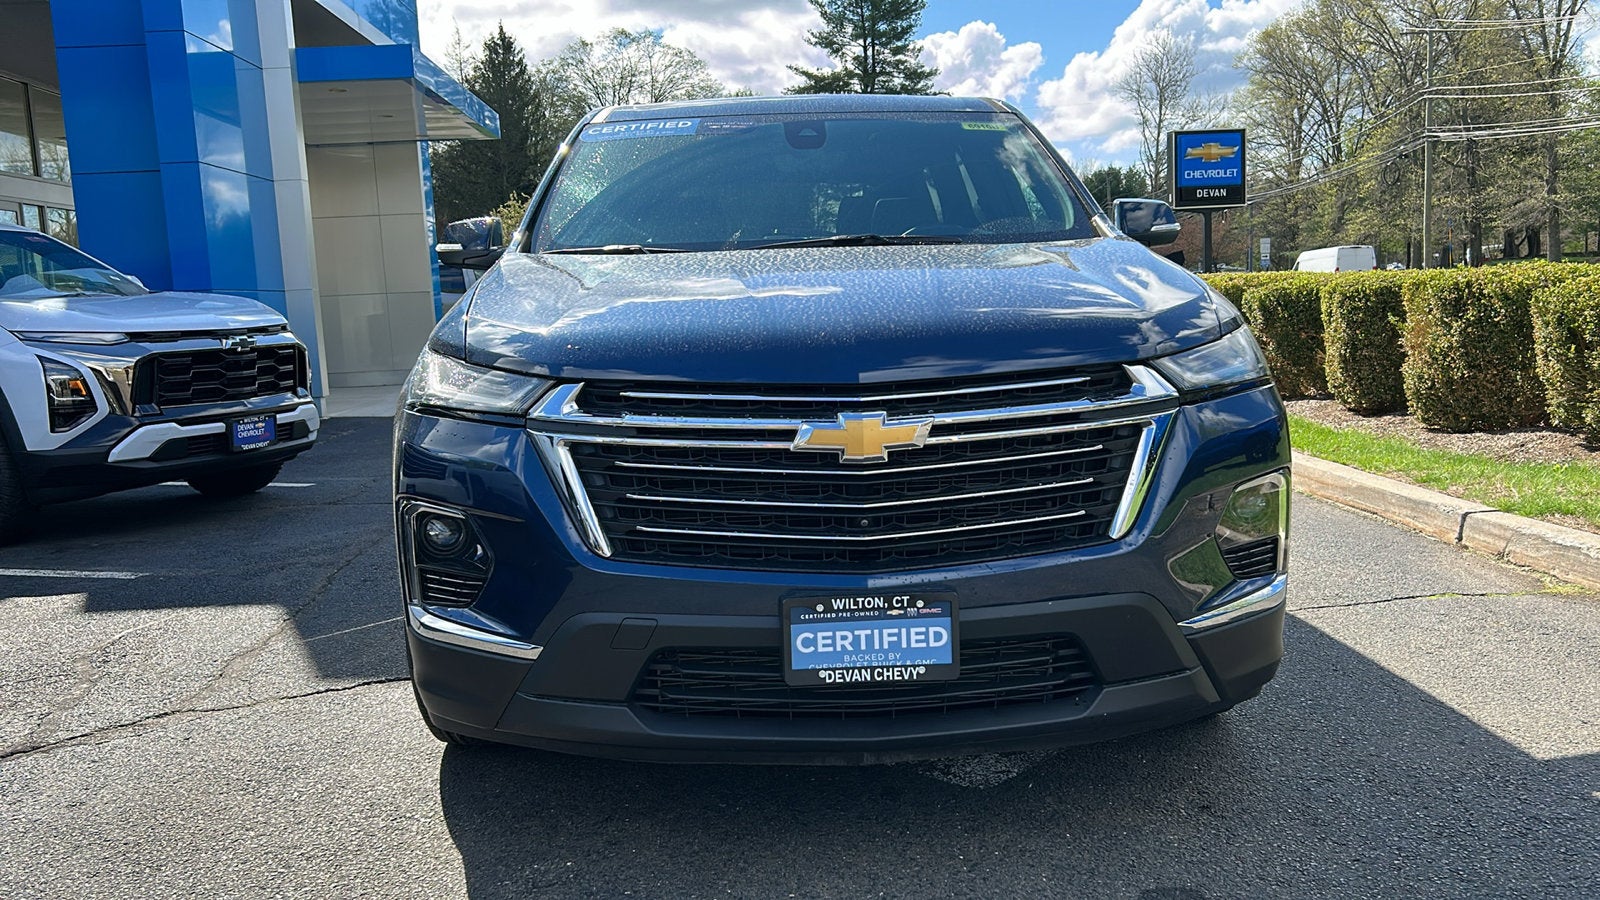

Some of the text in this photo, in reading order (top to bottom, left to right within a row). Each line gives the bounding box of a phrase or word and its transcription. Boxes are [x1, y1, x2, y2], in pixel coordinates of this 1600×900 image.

[588, 120, 692, 135] CERTIFIED
[1184, 168, 1238, 179] CHEVROLET
[1196, 188, 1227, 198] DEVAN
[237, 423, 254, 432] DEVAN
[237, 428, 265, 439] CHEVROLET
[831, 596, 910, 610] WILTON, CT
[800, 610, 879, 620] CERTIFIED PRE-OWNED
[796, 626, 948, 654] CERTIFIED
[843, 652, 901, 662] BACKED BY
[825, 666, 919, 683] DEVAN CHEVY
